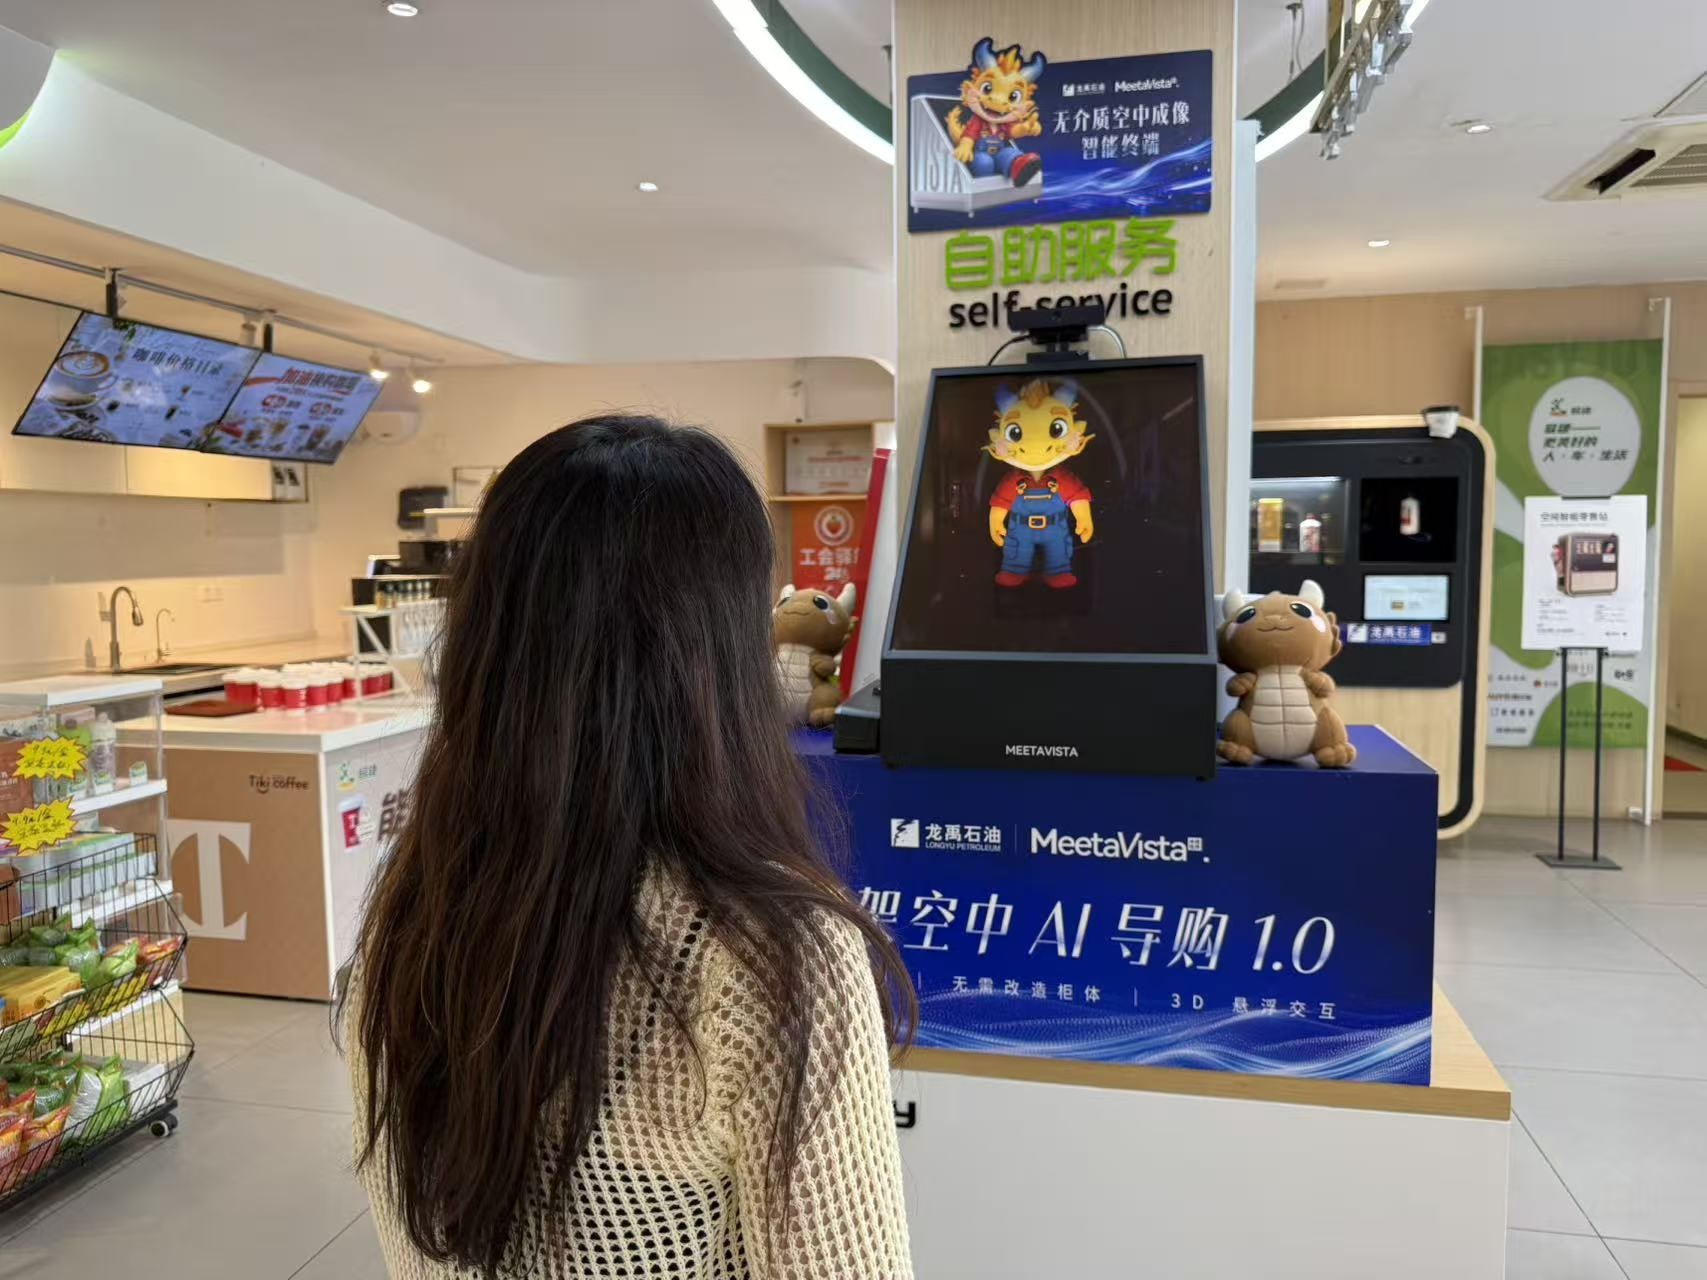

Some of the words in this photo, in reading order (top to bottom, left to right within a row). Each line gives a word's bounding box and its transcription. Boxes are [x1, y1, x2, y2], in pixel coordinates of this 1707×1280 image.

[1053, 101, 1190, 134] 无介质空中成像
[1081, 132, 1160, 159] 智能终端
[945, 217, 1177, 289] 自助服务
[1005, 744, 1079, 757] MEETAVISTA
[272, 776, 309, 790] coffee
[925, 823, 1001, 844] 龙禹石油
[925, 841, 956, 850] LONGYU
[956, 843, 1001, 853] PETROLEUM
[1028, 900, 1093, 959] AI
[1111, 903, 1231, 972] 导购
[1252, 913, 1337, 975] 1.0
[952, 976, 1101, 1003] 无需改造柜体
[1232, 996, 1337, 1021] 悬浮交互
